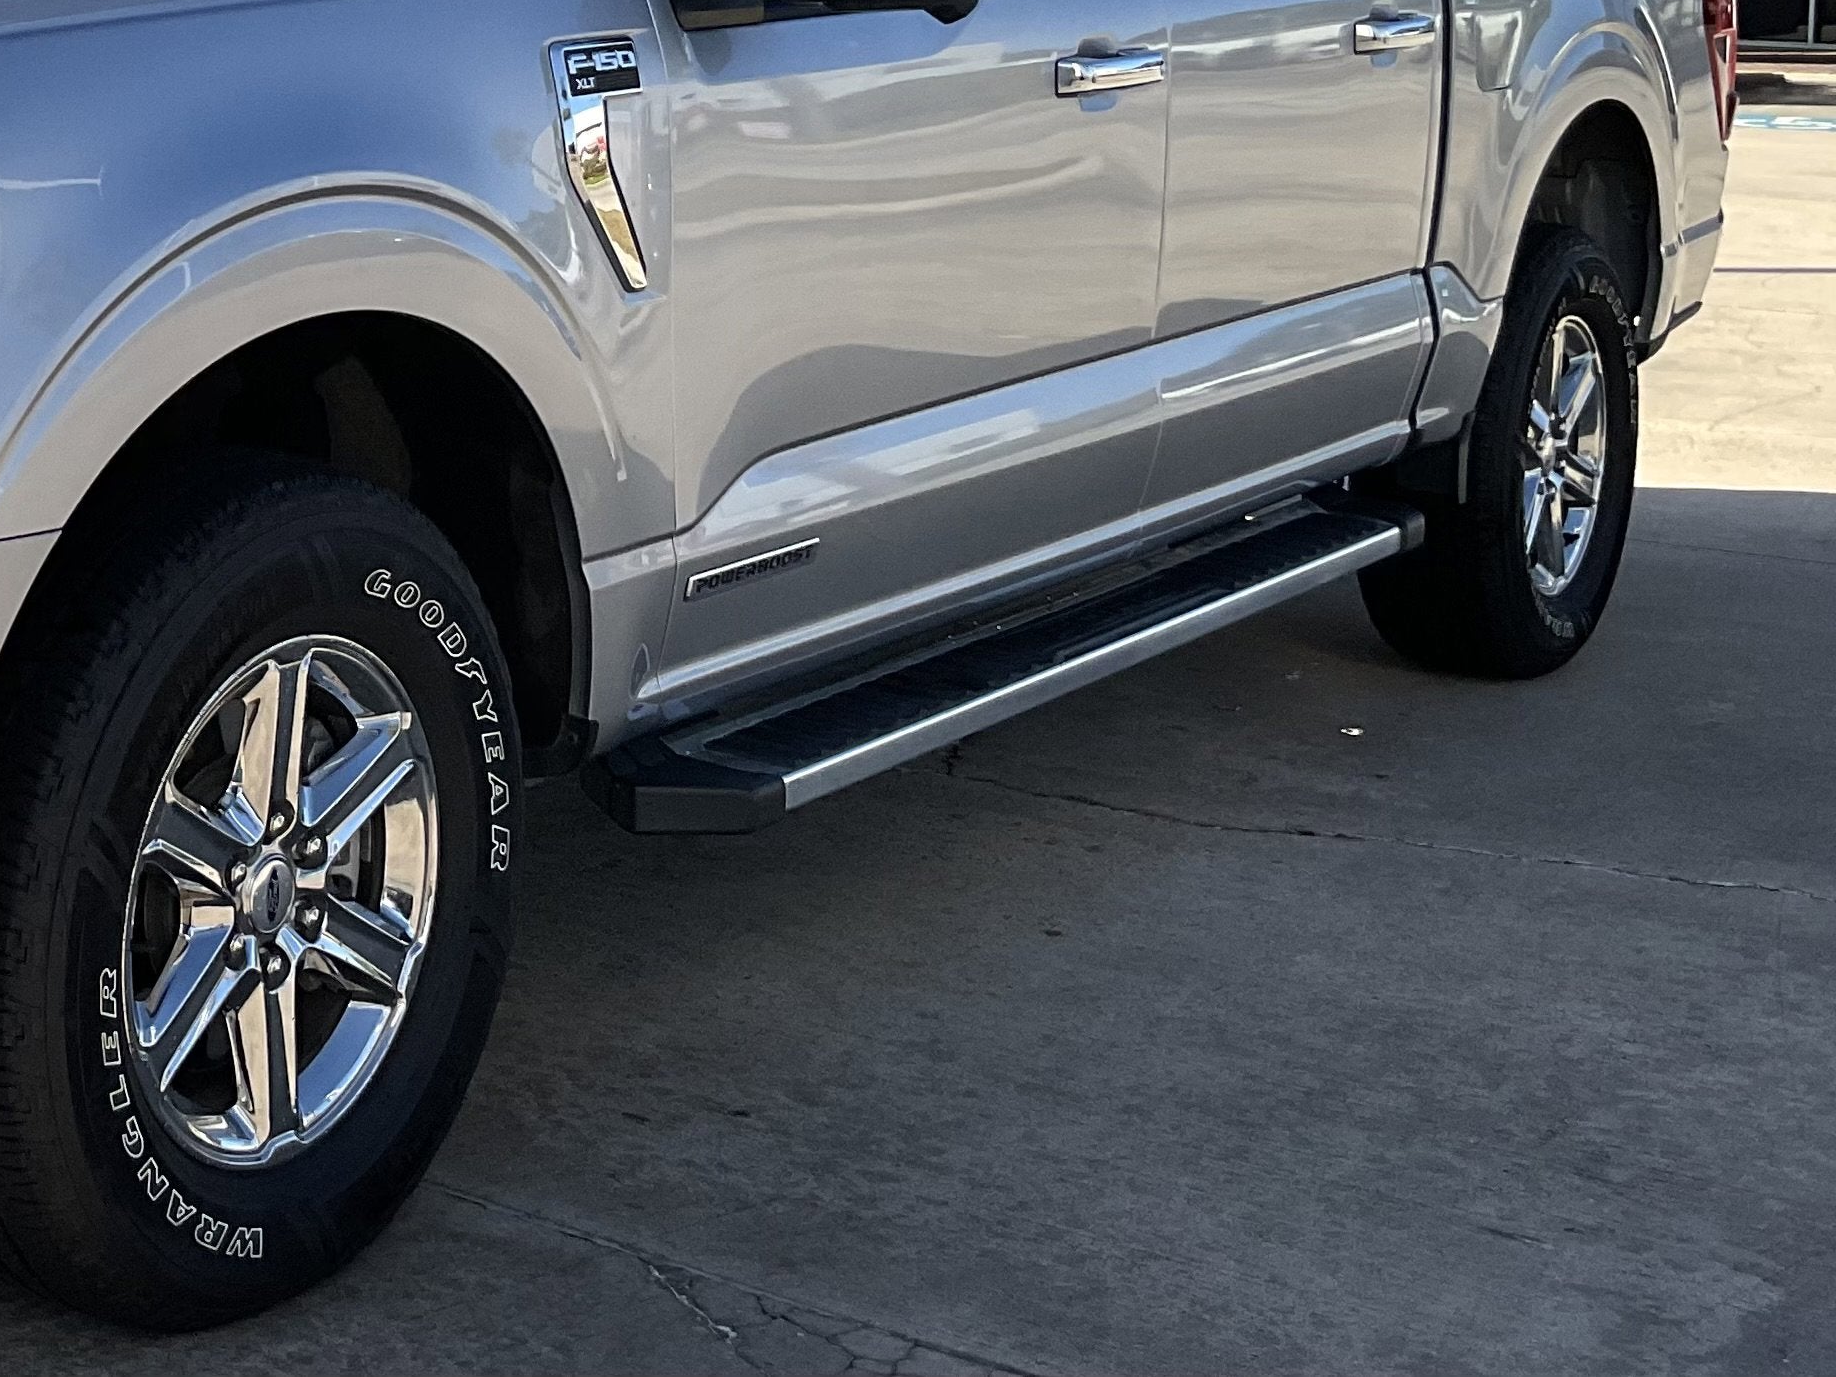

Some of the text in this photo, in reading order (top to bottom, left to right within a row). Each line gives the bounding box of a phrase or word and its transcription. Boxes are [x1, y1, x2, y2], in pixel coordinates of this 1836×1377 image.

[568, 50, 635, 75] F-150
[575, 76, 595, 90] XLT
[695, 547, 815, 593] POWERBOOST
[364, 569, 511, 871] GOODYEAR
[100, 967, 263, 1258] WRANGLER
